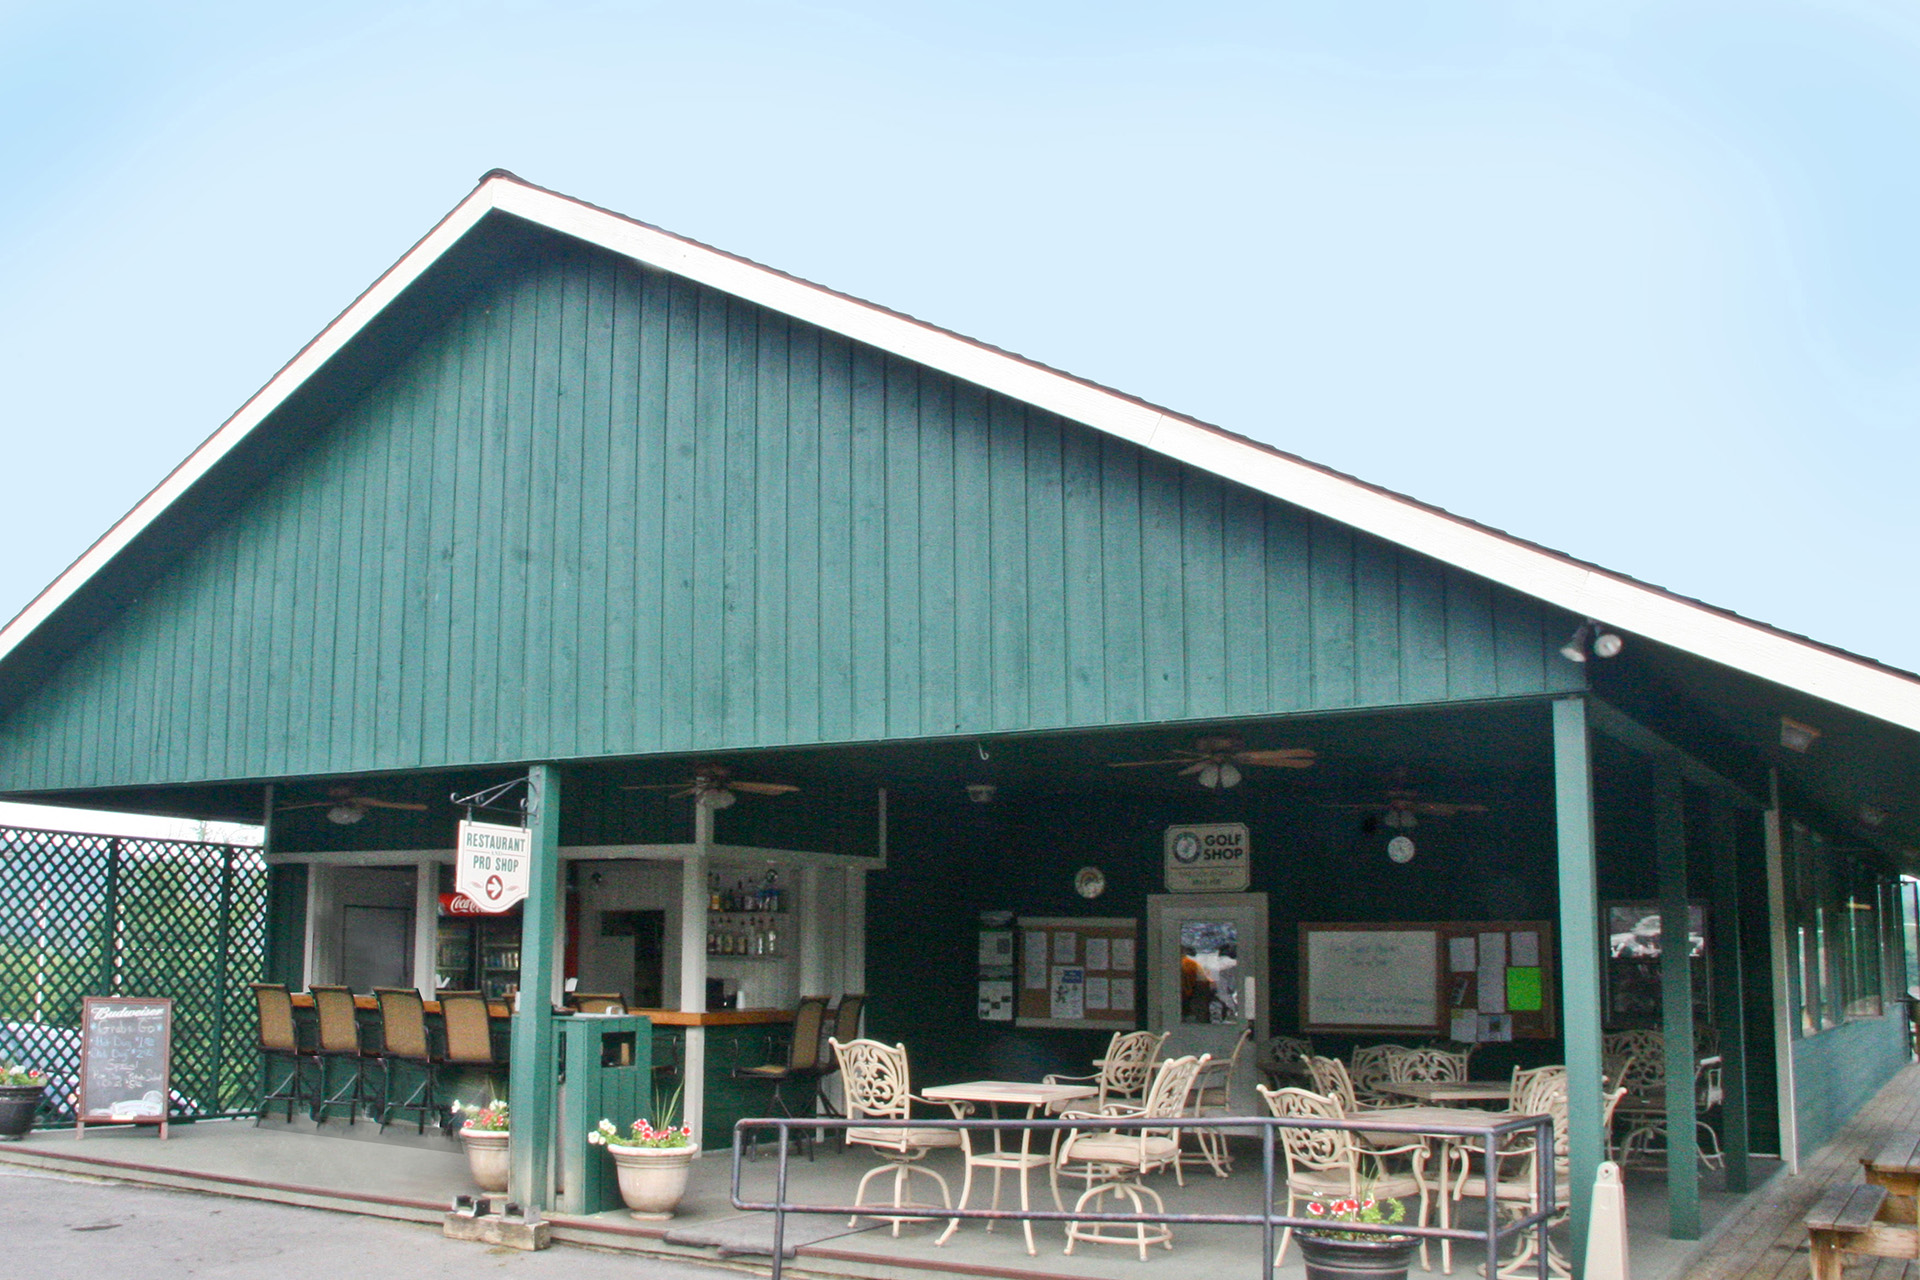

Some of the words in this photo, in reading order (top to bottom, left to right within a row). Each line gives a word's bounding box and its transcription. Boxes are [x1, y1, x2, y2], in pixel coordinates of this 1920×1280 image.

[467, 832, 525, 852] RESTAURANT
[1204, 835, 1241, 846] GOLF
[1204, 848, 1242, 860] SHOP
[473, 855, 491, 870] PRO
[495, 858, 519, 872] SHOP
[91, 1007, 164, 1020] Budweiser
[138, 1019, 155, 1034] Go
